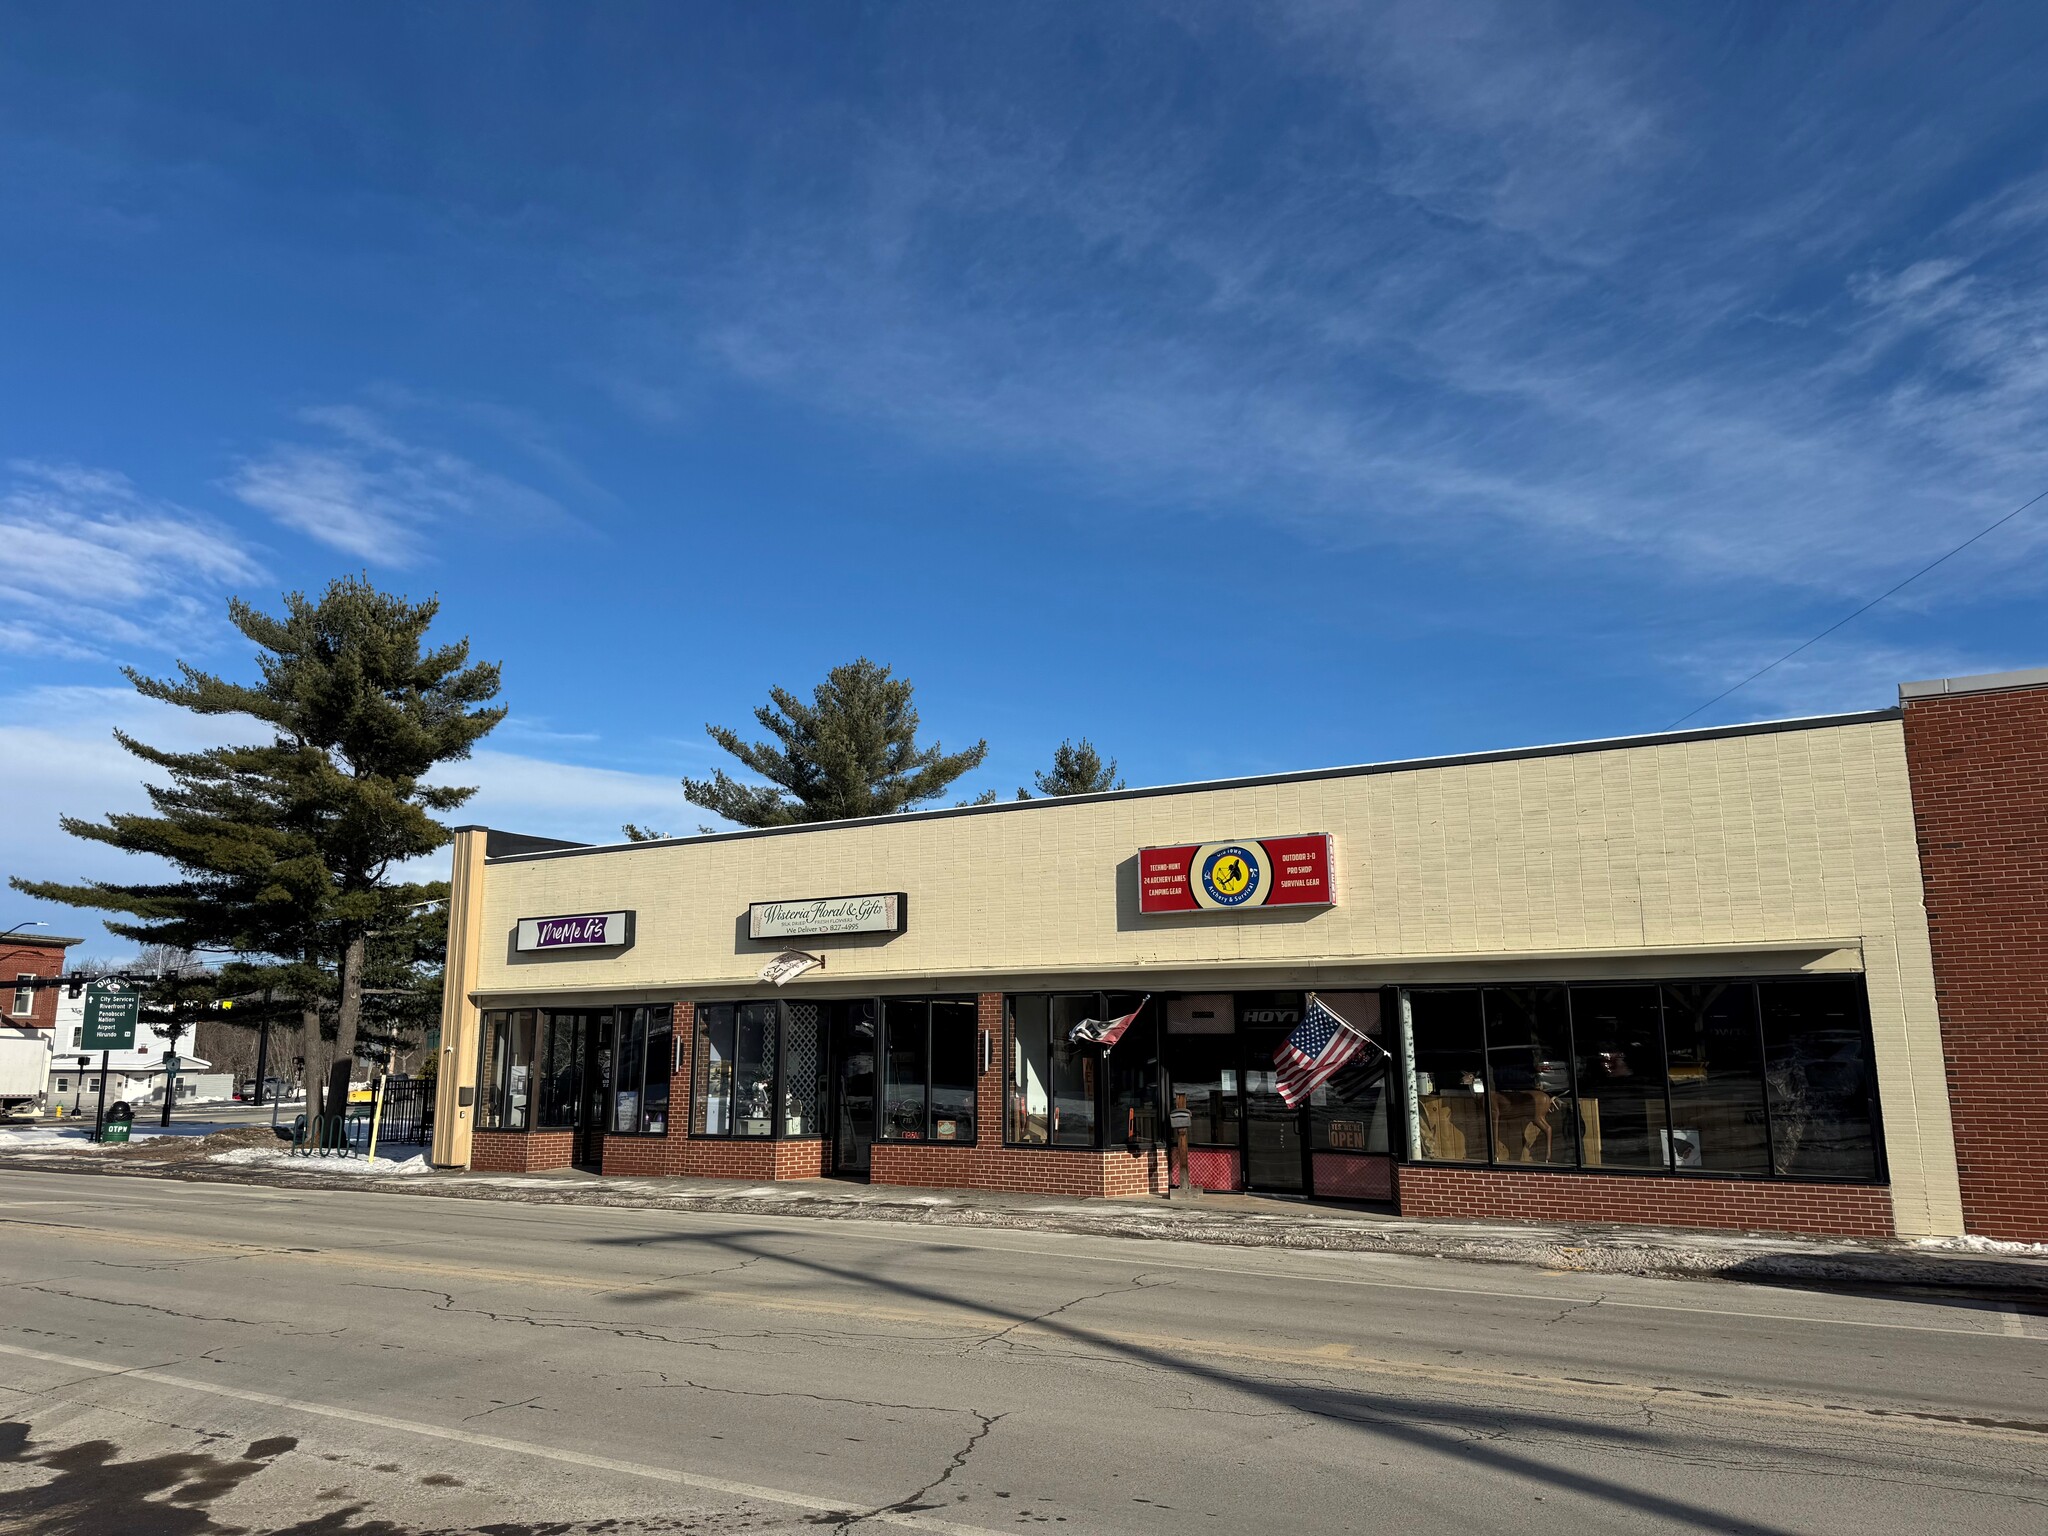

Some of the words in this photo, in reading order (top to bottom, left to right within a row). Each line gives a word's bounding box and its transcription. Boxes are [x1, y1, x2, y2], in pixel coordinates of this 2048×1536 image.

[1150, 863, 1180, 871] TECHNO-HUNT
[1151, 876, 1171, 884] ARCHERY
[1281, 880, 1305, 888] SURVIVAL
[1209, 886, 1227, 902] Archery
[1235, 883, 1254, 901] Survival
[764, 905, 809, 924] Wisteria
[806, 902, 847, 923] Floral
[846, 903, 857, 916] &
[855, 899, 883, 920] Gifts
[584, 919, 603, 942] G's
[97, 978, 111, 988] Old
[1243, 1010, 1299, 1022] HOYT
[1331, 1131, 1363, 1148] OPEN
